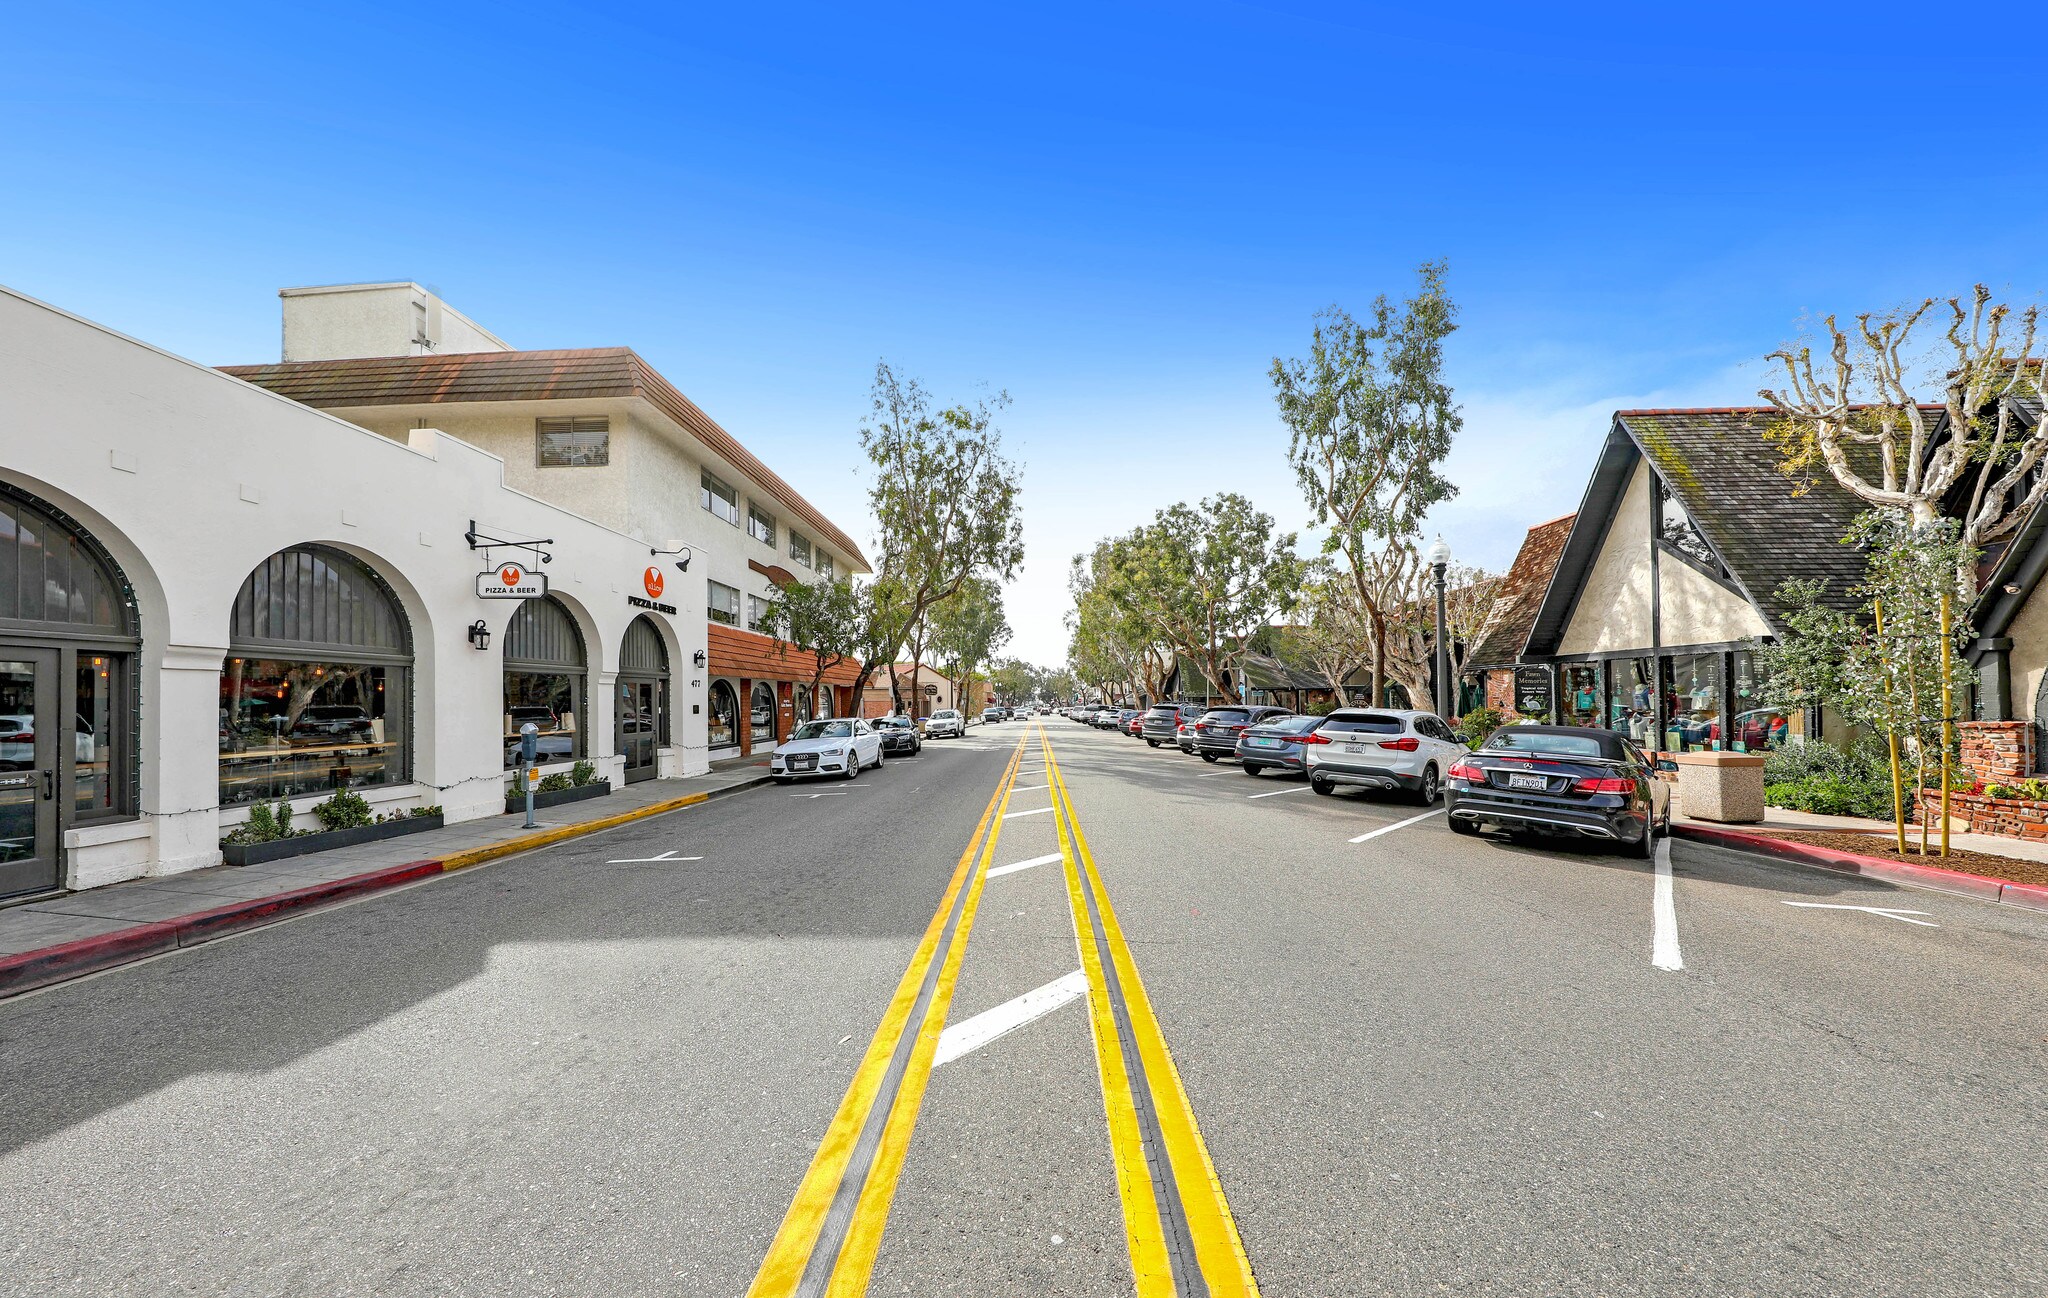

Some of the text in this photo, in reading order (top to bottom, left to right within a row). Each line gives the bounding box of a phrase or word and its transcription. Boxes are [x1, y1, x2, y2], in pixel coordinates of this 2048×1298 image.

[628, 595, 677, 615] PIZZA & BEER
[691, 679, 701, 688] 477
